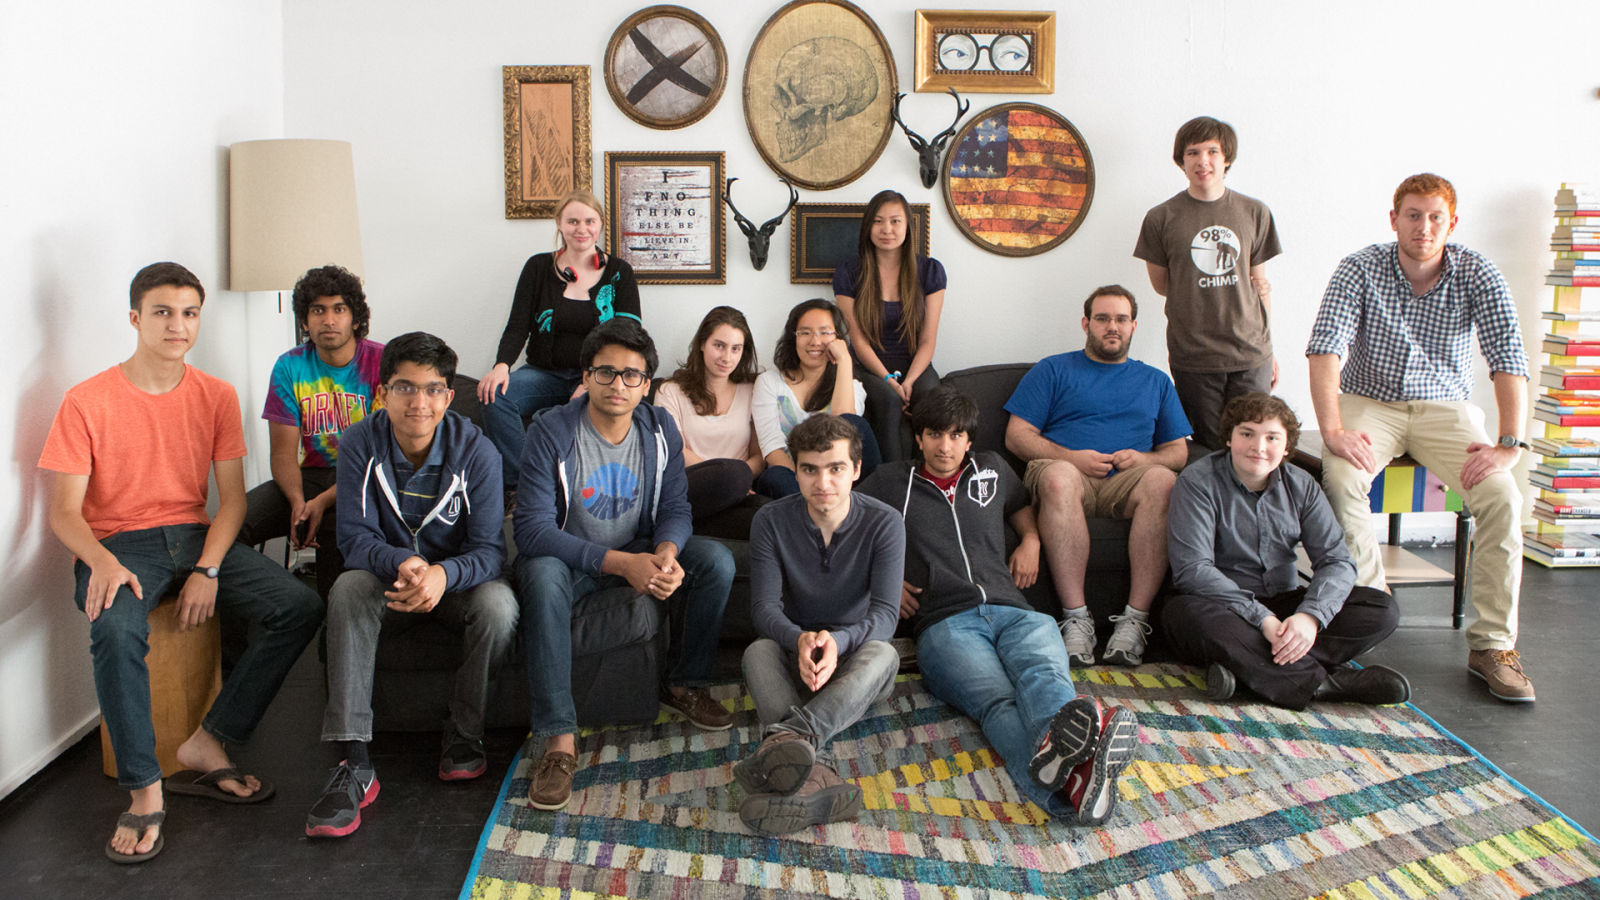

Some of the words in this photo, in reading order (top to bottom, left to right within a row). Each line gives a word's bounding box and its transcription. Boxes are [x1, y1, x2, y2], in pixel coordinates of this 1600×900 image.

[662, 171, 668, 183] I
[644, 191, 686, 201] FNO
[635, 208, 696, 217] THING
[1200, 229, 1232, 242] 98%
[1198, 275, 1239, 289] CHIMP
